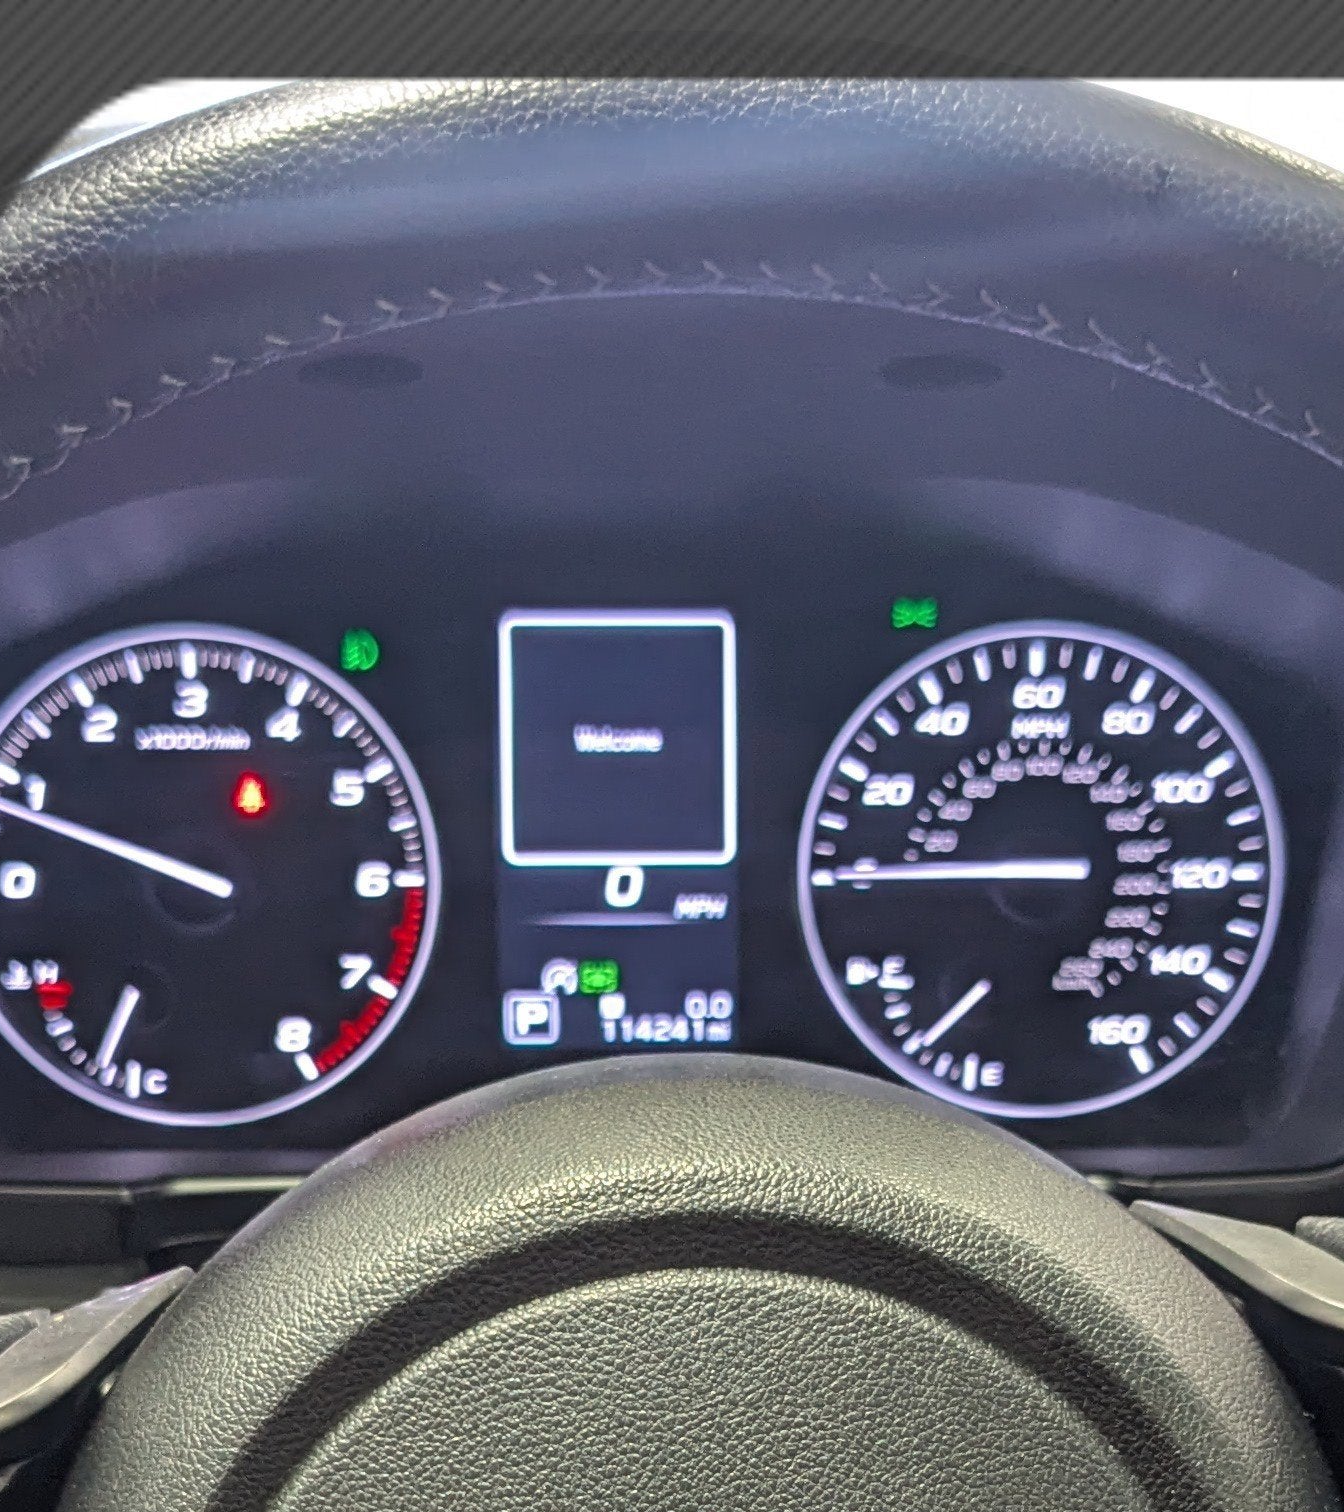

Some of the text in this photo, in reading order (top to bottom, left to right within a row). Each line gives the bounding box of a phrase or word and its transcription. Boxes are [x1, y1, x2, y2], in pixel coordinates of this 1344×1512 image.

[172, 679, 209, 718] 3
[1012, 677, 1067, 709] 60
[81, 706, 118, 742] 2
[265, 709, 302, 742] 4
[915, 702, 971, 736] 40
[1011, 712, 1071, 739] MPH
[25, 775, 47, 811] 1
[330, 769, 365, 806] 5
[862, 774, 914, 806] 20
[1152, 771, 1215, 804] 100
[356, 862, 391, 897] 6
[604, 866, 644, 907] 0
[1171, 857, 1233, 889] 120
[339, 954, 372, 989] 7
[1149, 945, 1212, 975] 140
[276, 1017, 311, 1052] 8
[516, 1002, 548, 1035] P
[1089, 1014, 1152, 1045] 160
[144, 1069, 167, 1094] C
[981, 1061, 1004, 1087] E
